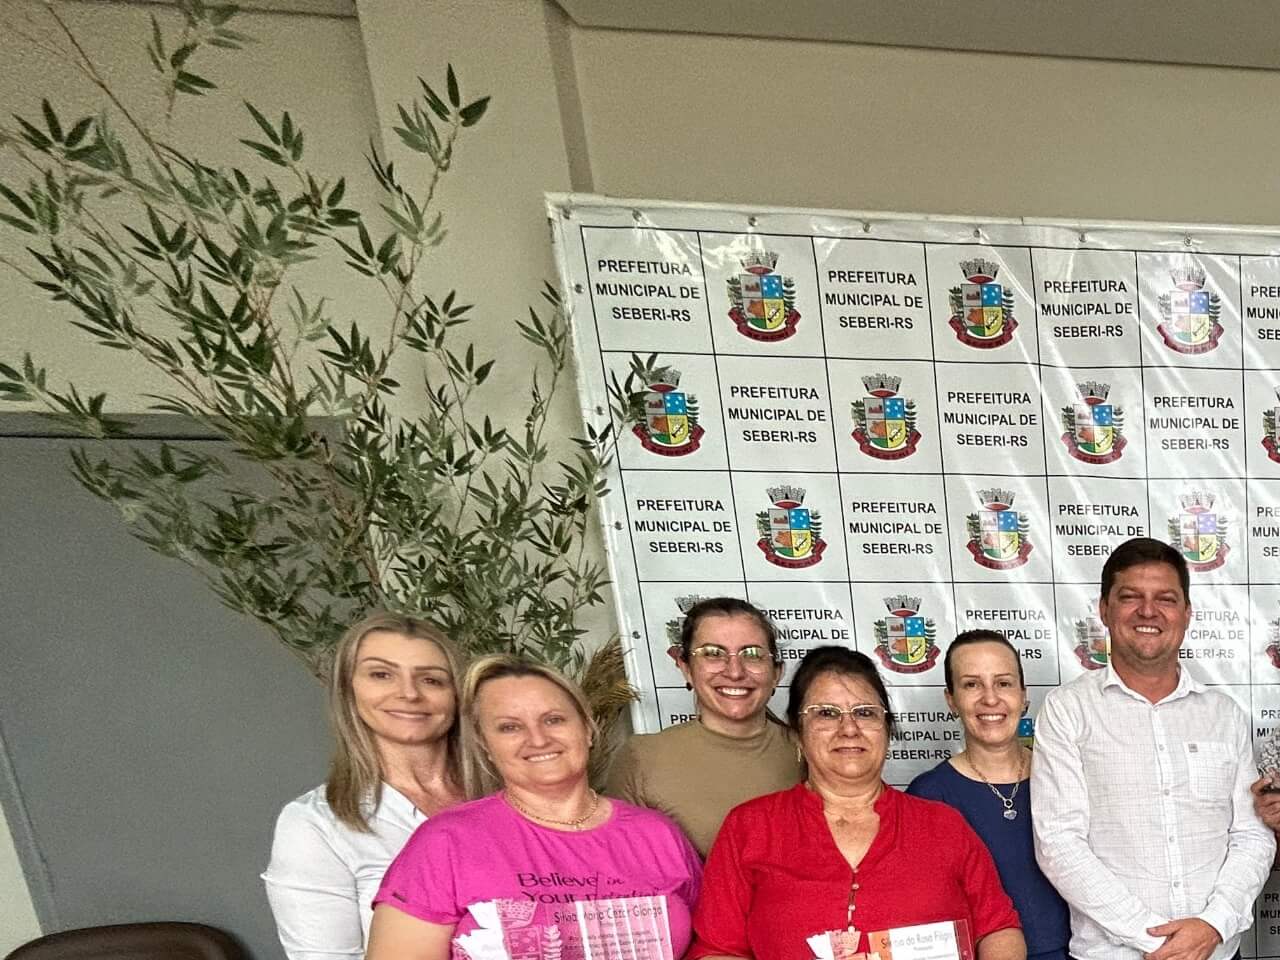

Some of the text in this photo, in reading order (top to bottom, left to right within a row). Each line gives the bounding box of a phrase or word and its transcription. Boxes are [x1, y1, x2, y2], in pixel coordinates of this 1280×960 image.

[597, 259, 692, 276] PREFEITURA
[828, 270, 917, 286] PREFEITURA
[596, 283, 700, 299] MUNICIPAL DE
[1044, 280, 1127, 293] PREFEITURA
[825, 293, 924, 308] MUNICIPAL DE
[612, 306, 691, 322] SEBERI-RS
[1041, 302, 1133, 316] MUNICIPAL DE
[839, 316, 913, 329] SEBERI-RS
[1053, 325, 1123, 338] SEBERI-RS
[730, 386, 819, 400] PREFEITURA
[947, 392, 1031, 404] PREFEITURA
[1154, 396, 1234, 409] PREFEITURA
[728, 408, 826, 422] MUNICIPAL DE
[944, 412, 1037, 426] MUNICIPAL DE
[1150, 418, 1239, 430] MUNICIPAL DE
[742, 430, 817, 443] SEBERI-RS
[956, 434, 1028, 447] SEBERI-RS
[1161, 438, 1230, 450] SEBERI-RS
[637, 500, 725, 512] PREFEITURA
[852, 502, 936, 514] PREFEITURA
[1059, 504, 1139, 517] PREFEITURA
[634, 521, 732, 533] MUNICIPAL DE
[849, 522, 942, 534] MUNICIPAL DE
[1055, 524, 1144, 536] MUNICIPAL DE
[649, 541, 724, 554] SEBERI-RS
[862, 543, 933, 555] SEBERI-RS
[966, 609, 1046, 621] PREFEITURA
[1191, 610, 1240, 621] EITURA
[777, 629, 849, 640] NICIPAL DE
[1034, 629, 1052, 640] DE
[1228, 630, 1244, 640] DE
[1178, 648, 1235, 659] EBERI-RS
[891, 712, 955, 723] EFEITURA
[891, 731, 961, 741] NICIPAL DE
